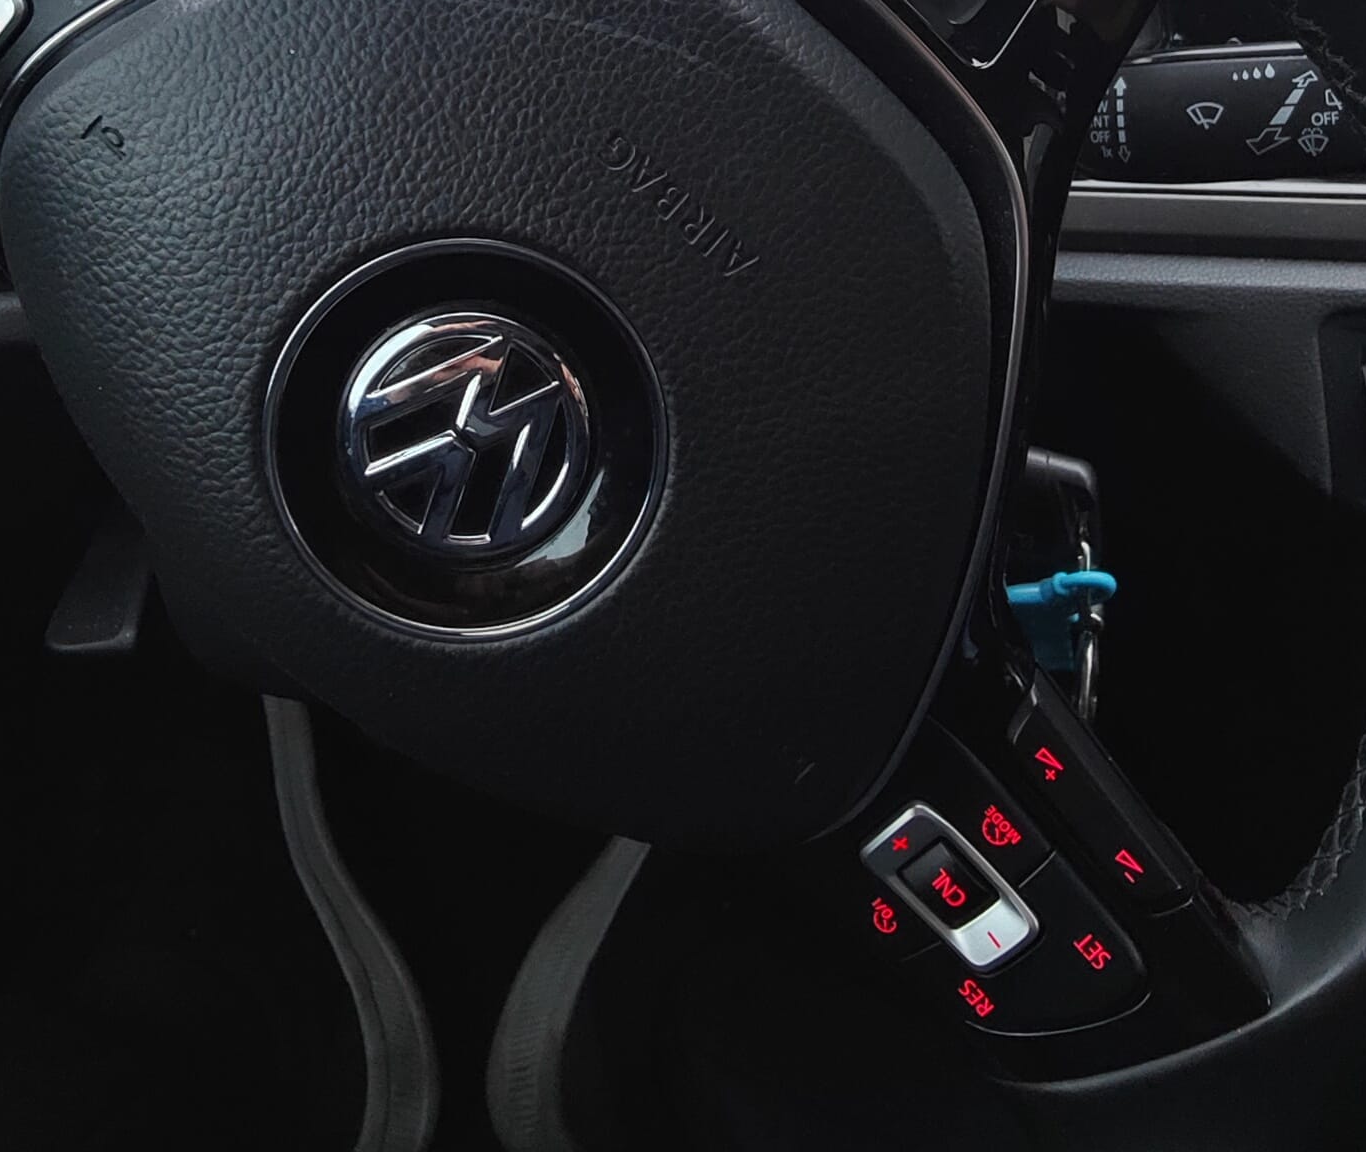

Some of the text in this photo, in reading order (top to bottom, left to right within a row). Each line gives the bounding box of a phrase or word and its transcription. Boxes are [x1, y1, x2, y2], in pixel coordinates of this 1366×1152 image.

[1089, 130, 1111, 144] OFF
[1310, 110, 1341, 127] OFF
[984, 805, 1022, 846] MODE
[931, 867, 968, 908] CNL
[1072, 933, 1112, 970] SET
[958, 979, 995, 1017] RES
